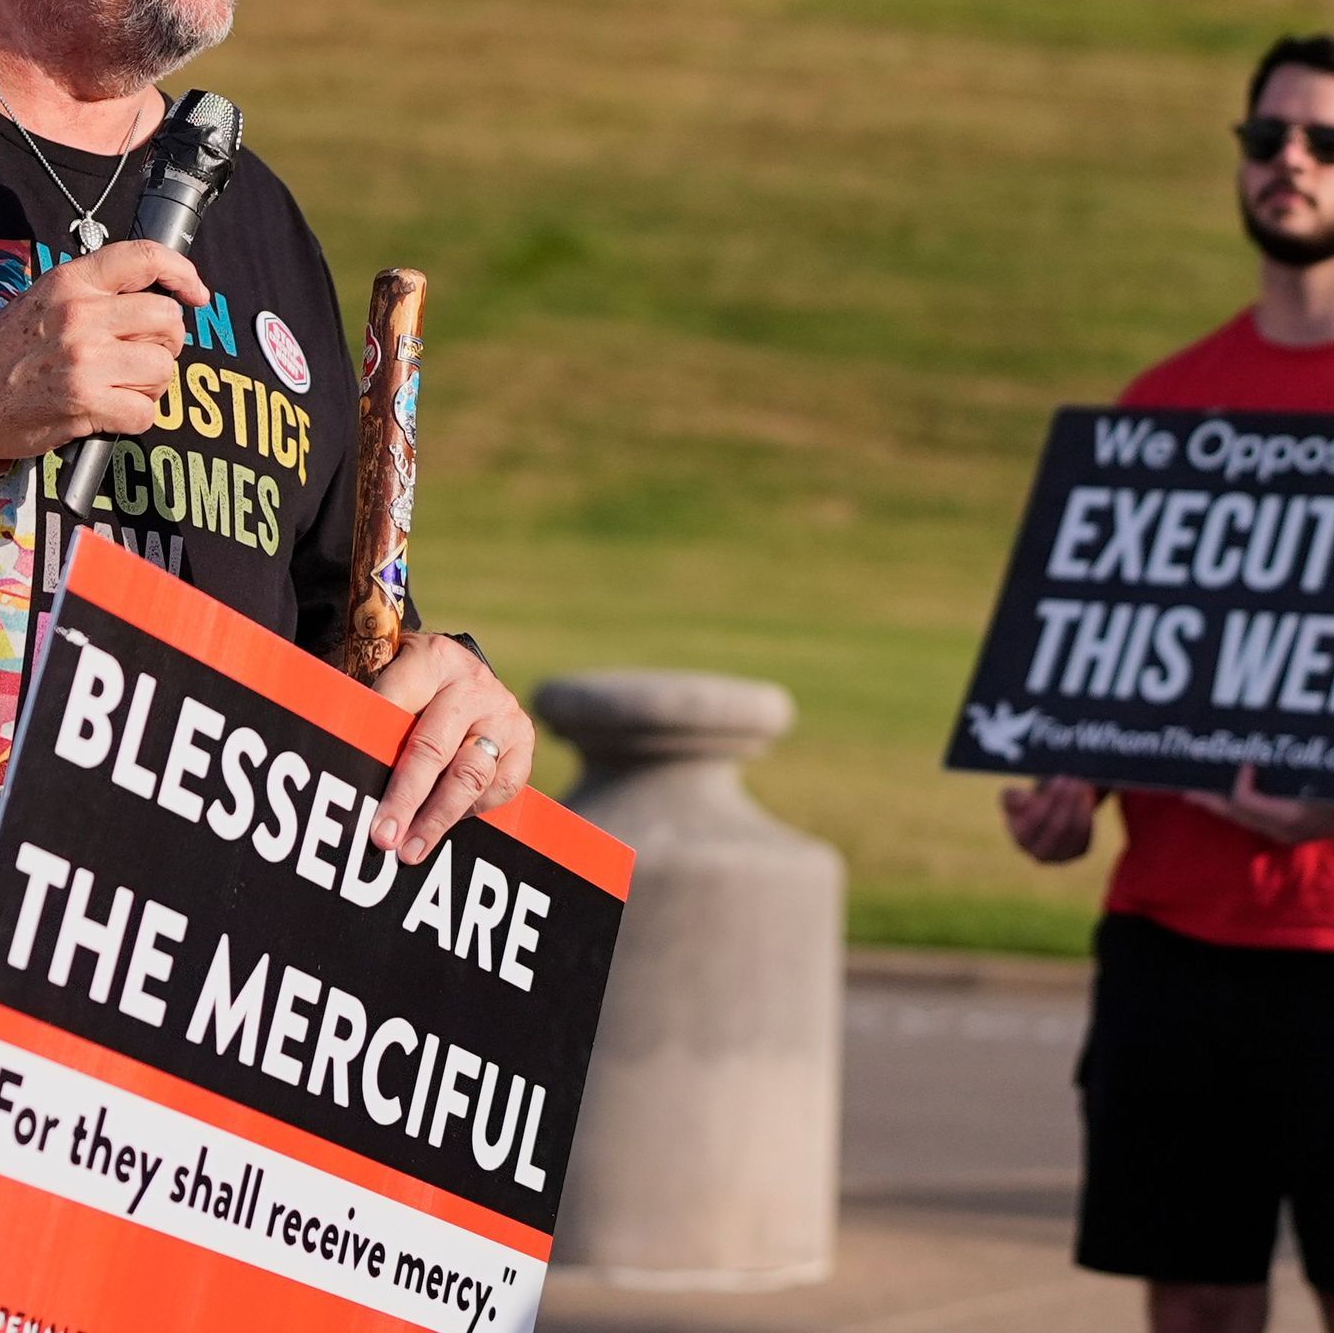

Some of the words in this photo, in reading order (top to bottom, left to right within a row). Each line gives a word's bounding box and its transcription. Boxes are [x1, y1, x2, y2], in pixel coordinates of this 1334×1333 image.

[1093, 417, 1175, 467] We
[1025, 599, 1205, 704] THIS
[54, 643, 399, 910] BLESSED
[402, 839, 552, 993] ARE
[6, 841, 190, 1028] THE
[185, 932, 548, 1194] MERCIFUL
[69, 1105, 163, 1216] they
[169, 1145, 265, 1231] shall
[266, 1207, 387, 1279] receive
[393, 1250, 518, 1333] mercy."
